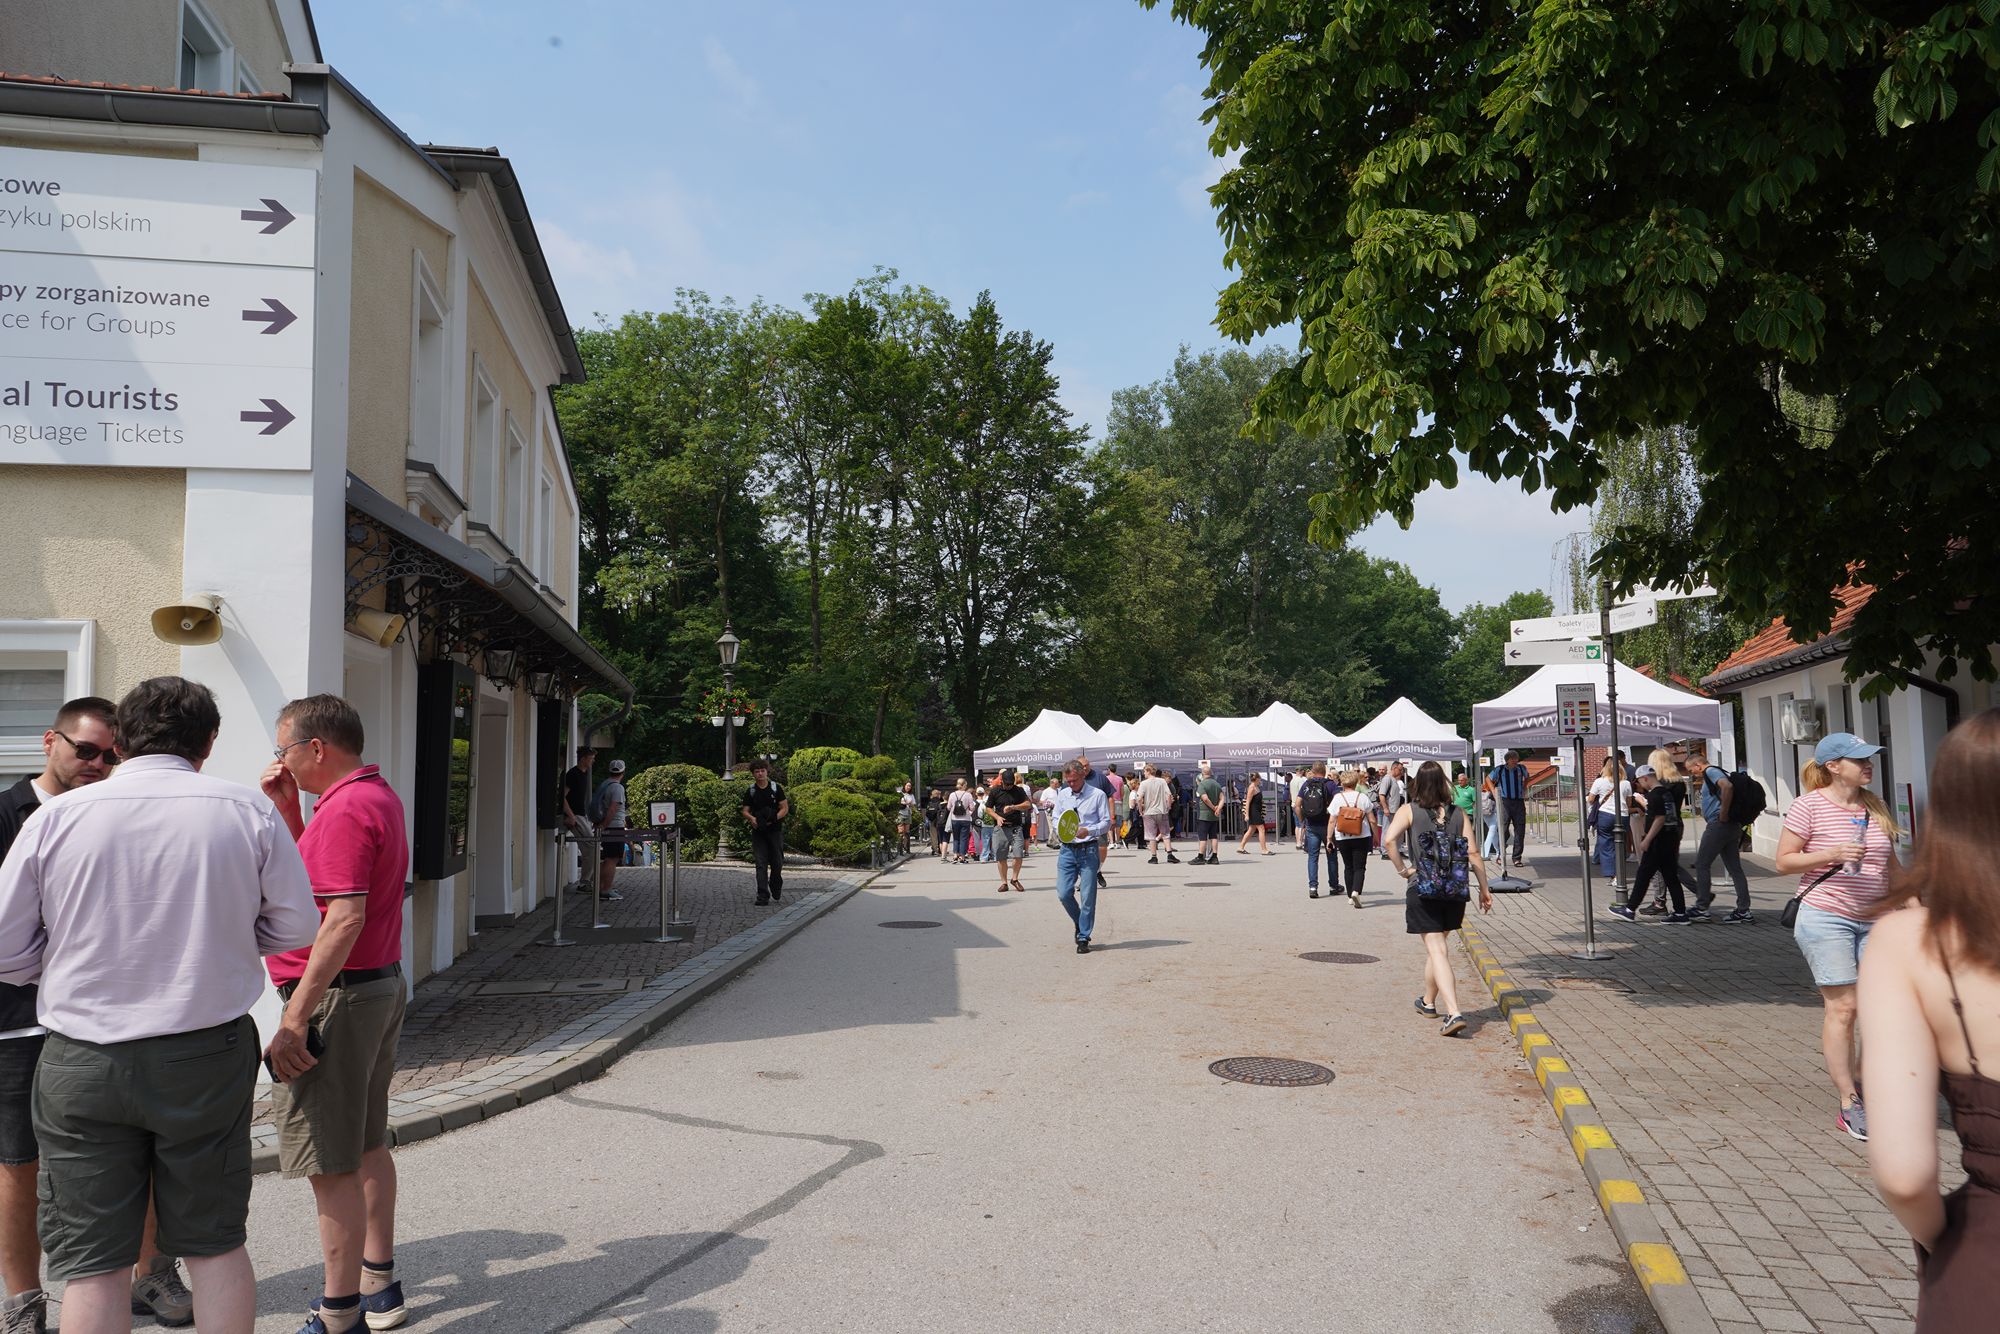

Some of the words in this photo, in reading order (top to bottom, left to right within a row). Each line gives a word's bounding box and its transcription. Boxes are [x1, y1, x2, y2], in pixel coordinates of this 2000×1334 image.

[0, 205, 51, 228] zyku
[61, 210, 151, 232] polskim
[36, 286, 210, 307] zorganizowane
[2, 313, 30, 329] ce
[40, 310, 77, 331] for
[86, 312, 176, 339] Groups
[3, 380, 30, 406] al
[44, 381, 179, 411] Tourists
[0, 424, 87, 446] nguage
[97, 422, 184, 444] Tickets
[1558, 619, 1582, 629] Toalety
[1568, 645, 1585, 653] AED
[1105, 748, 1182, 760] www.kopalnia.pl
[1228, 745, 1309, 757] www.kopalnia.pl
[1355, 743, 1442, 755] www.kopalnia.pl
[993, 751, 1063, 764] www.kopalnia.pl
